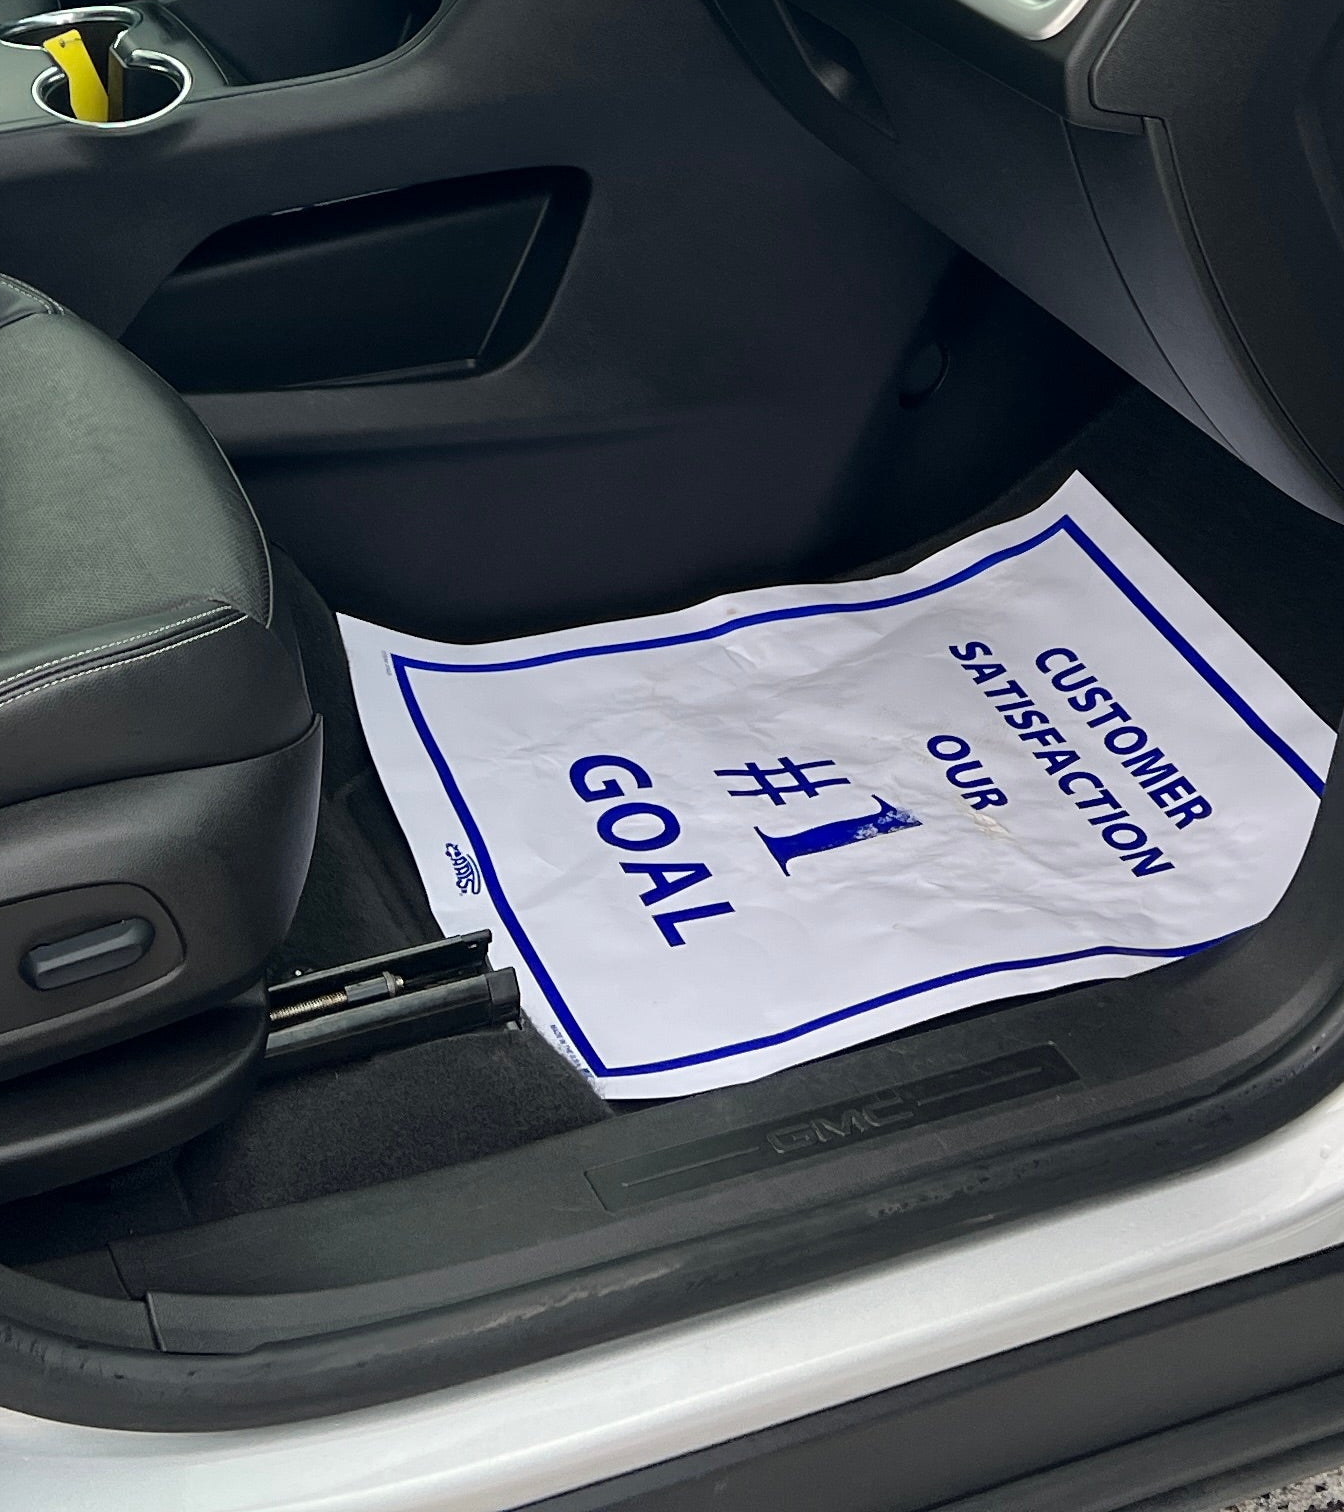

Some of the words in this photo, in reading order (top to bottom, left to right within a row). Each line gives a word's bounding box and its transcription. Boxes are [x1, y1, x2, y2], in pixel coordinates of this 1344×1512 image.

[926, 734, 1009, 811] OUR
[948, 640, 1176, 878] SATISFACTION
[1035, 646, 1213, 831] CUSTOMER
[568, 753, 737, 948] GOAL
[713, 756, 924, 877] #1
[766, 1088, 914, 1154] GMC
